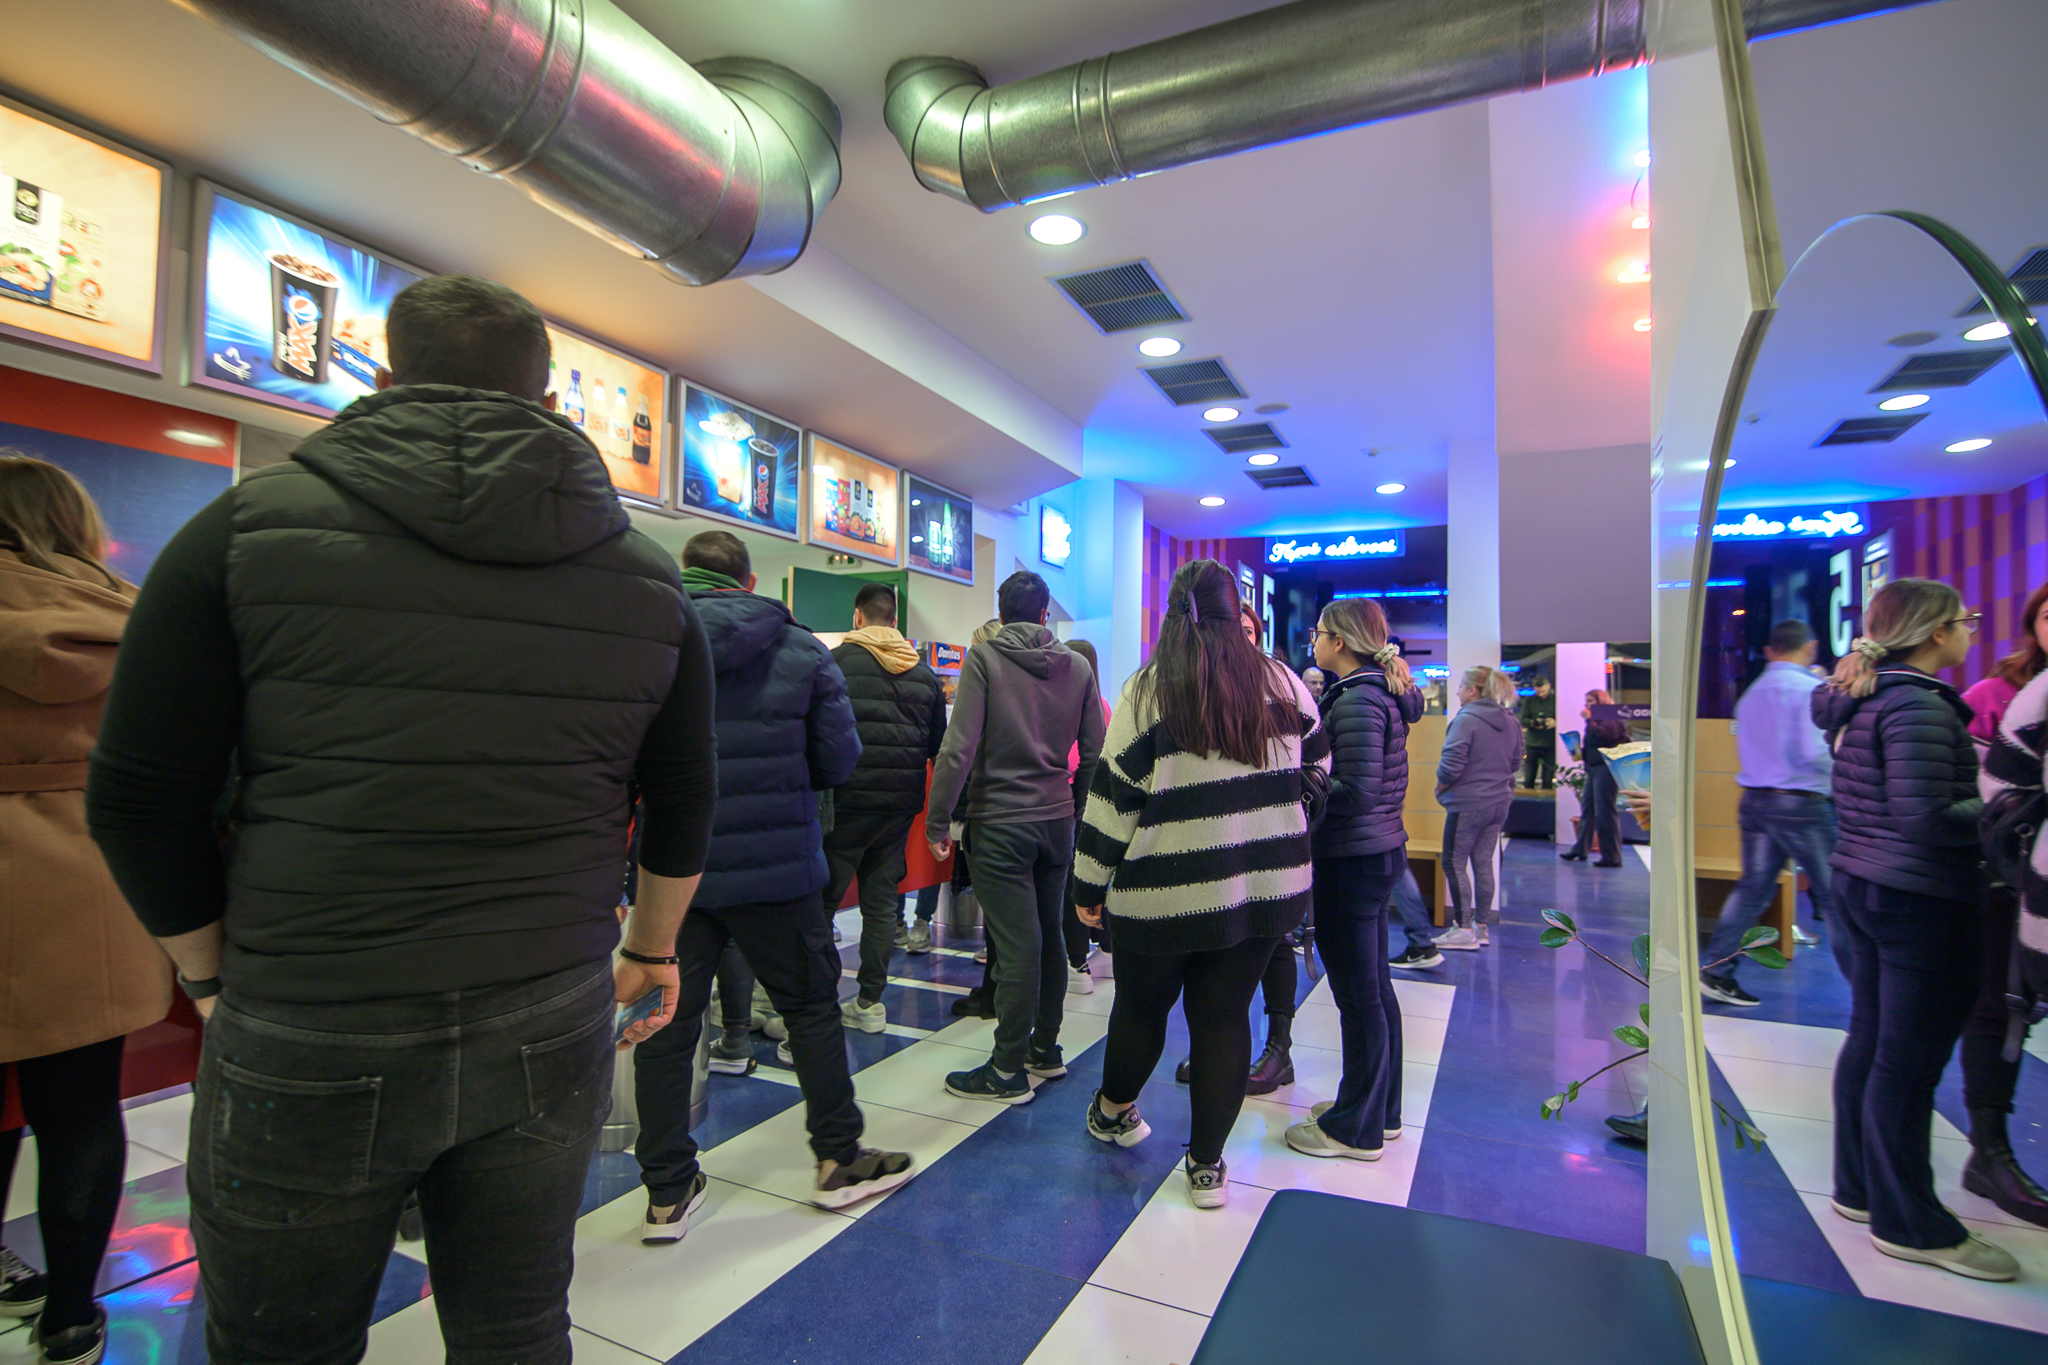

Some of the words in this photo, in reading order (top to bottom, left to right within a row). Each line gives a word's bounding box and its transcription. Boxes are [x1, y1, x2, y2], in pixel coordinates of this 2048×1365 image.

[286, 313, 318, 377] MAX
[1263, 573, 1275, 658] 5
[938, 646, 961, 660] Doritos
